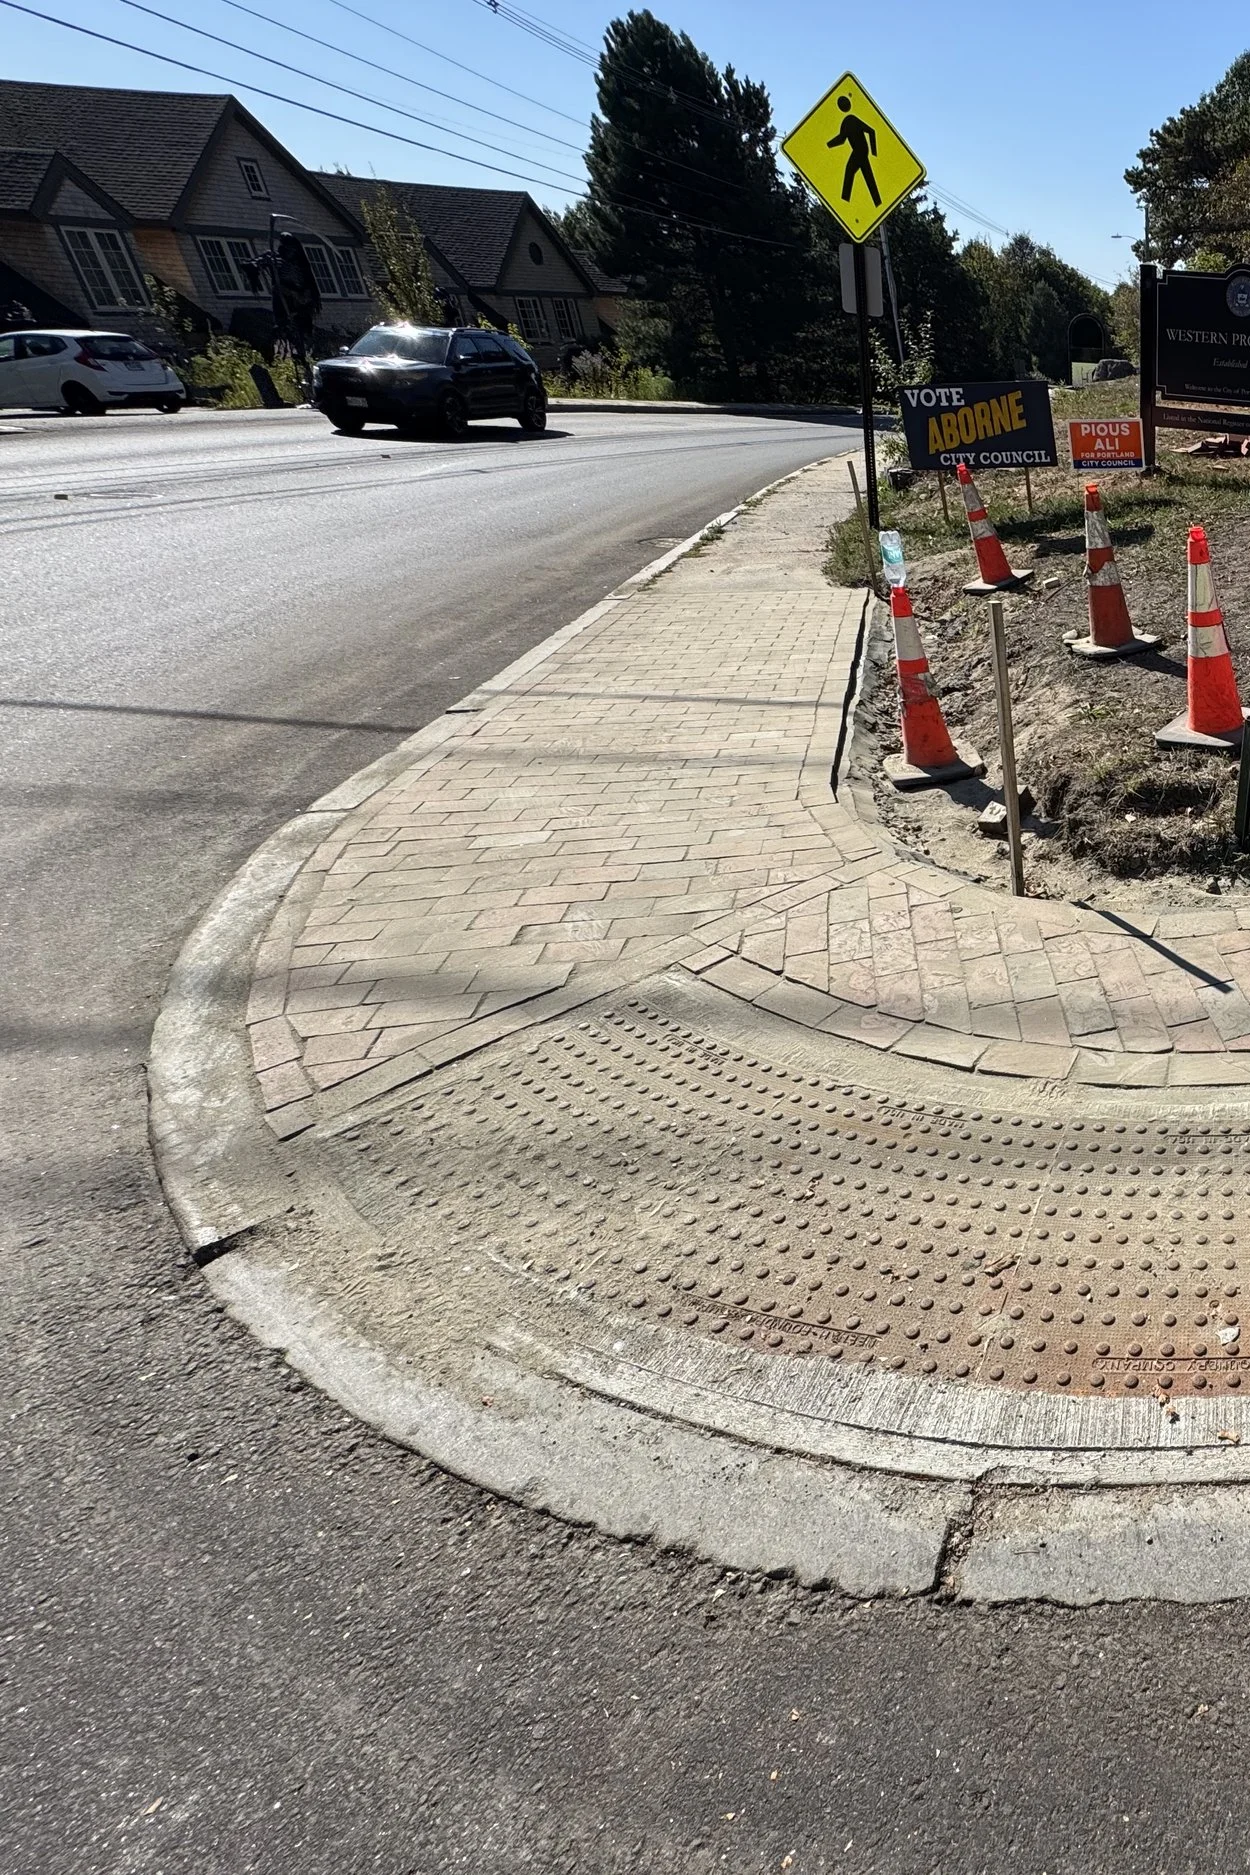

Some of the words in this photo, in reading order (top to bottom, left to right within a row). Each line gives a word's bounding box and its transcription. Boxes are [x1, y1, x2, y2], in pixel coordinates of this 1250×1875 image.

[1166, 328, 1228, 345] WESTERN
[1213, 358, 1249, 369] Established
[904, 388, 965, 407] VOTE
[928, 390, 1027, 455] ABORNE
[1197, 416, 1222, 426] National
[1080, 423, 1130, 437] PIOUS
[1094, 438, 1120, 450] ALI
[940, 452, 975, 466] CITY
[979, 450, 1051, 465] COUNCIL
